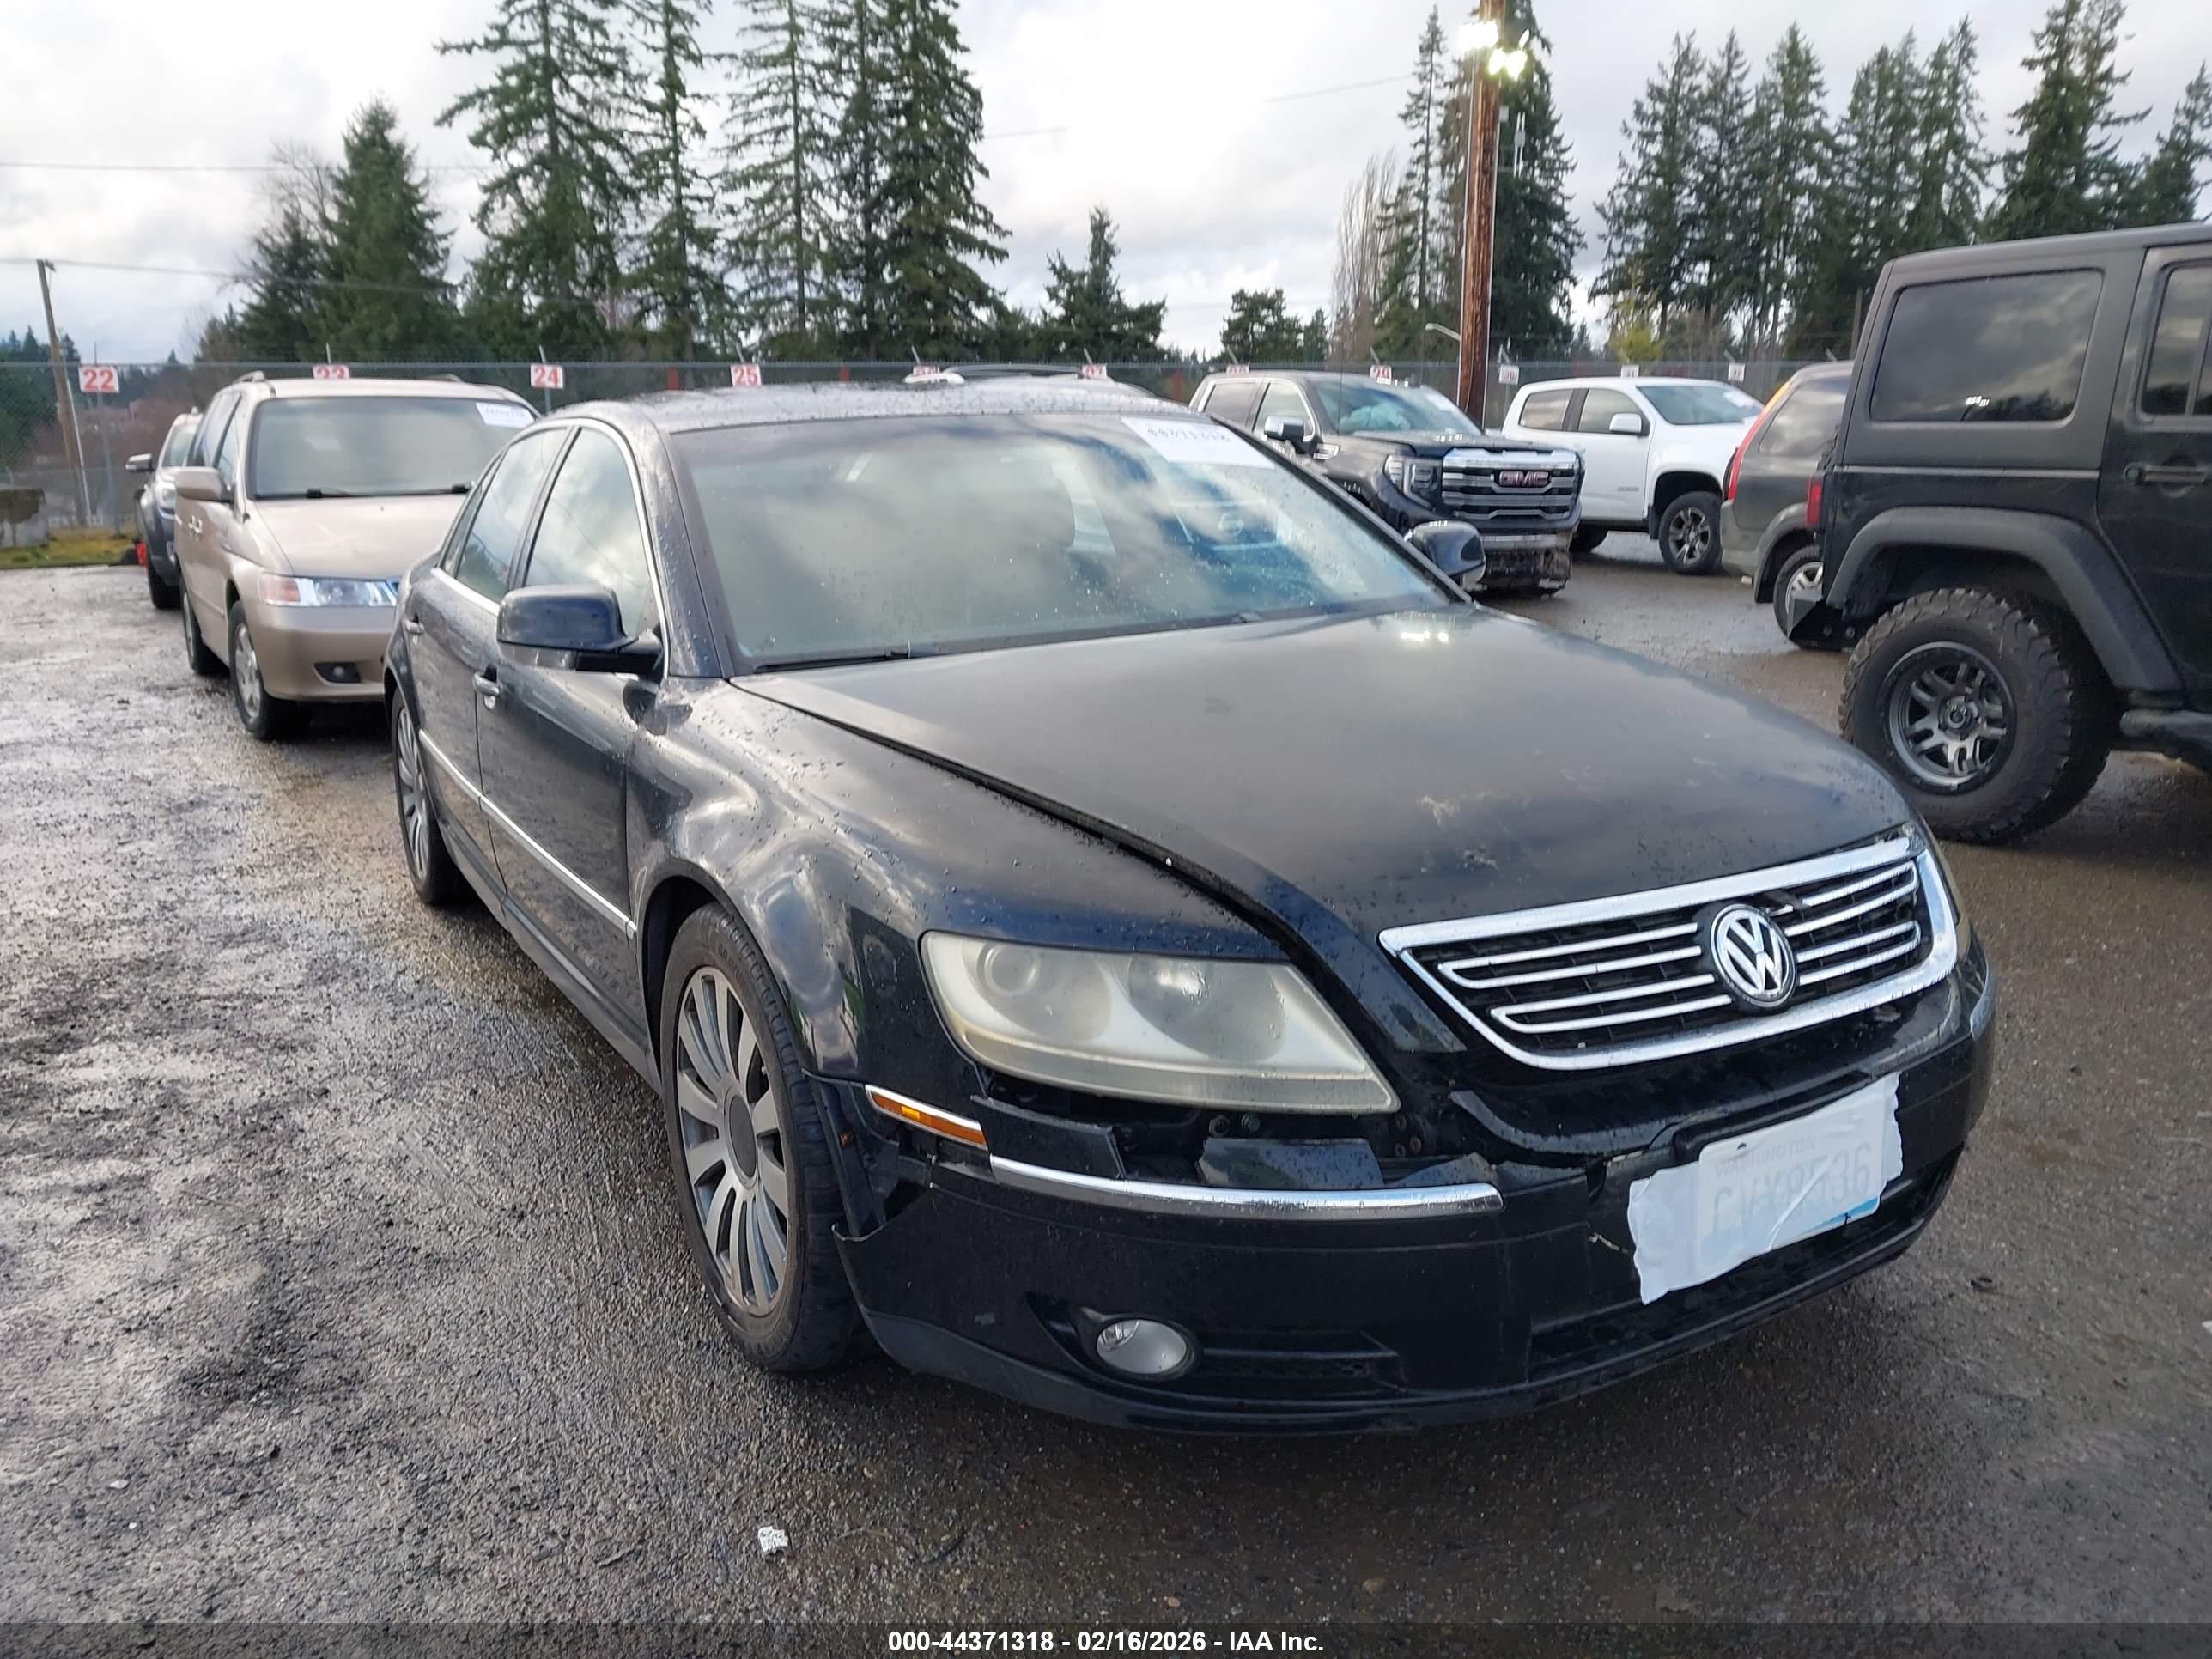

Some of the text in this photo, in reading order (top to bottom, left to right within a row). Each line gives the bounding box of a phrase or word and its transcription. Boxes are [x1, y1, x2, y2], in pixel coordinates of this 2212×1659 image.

[82, 369, 114, 391] 22
[534, 367, 560, 386] 24
[734, 366, 757, 386] 25
[1499, 471, 1549, 487] GMC
[1717, 908, 1790, 999] VW
[1716, 1135, 1816, 1178] WASHINGTON
